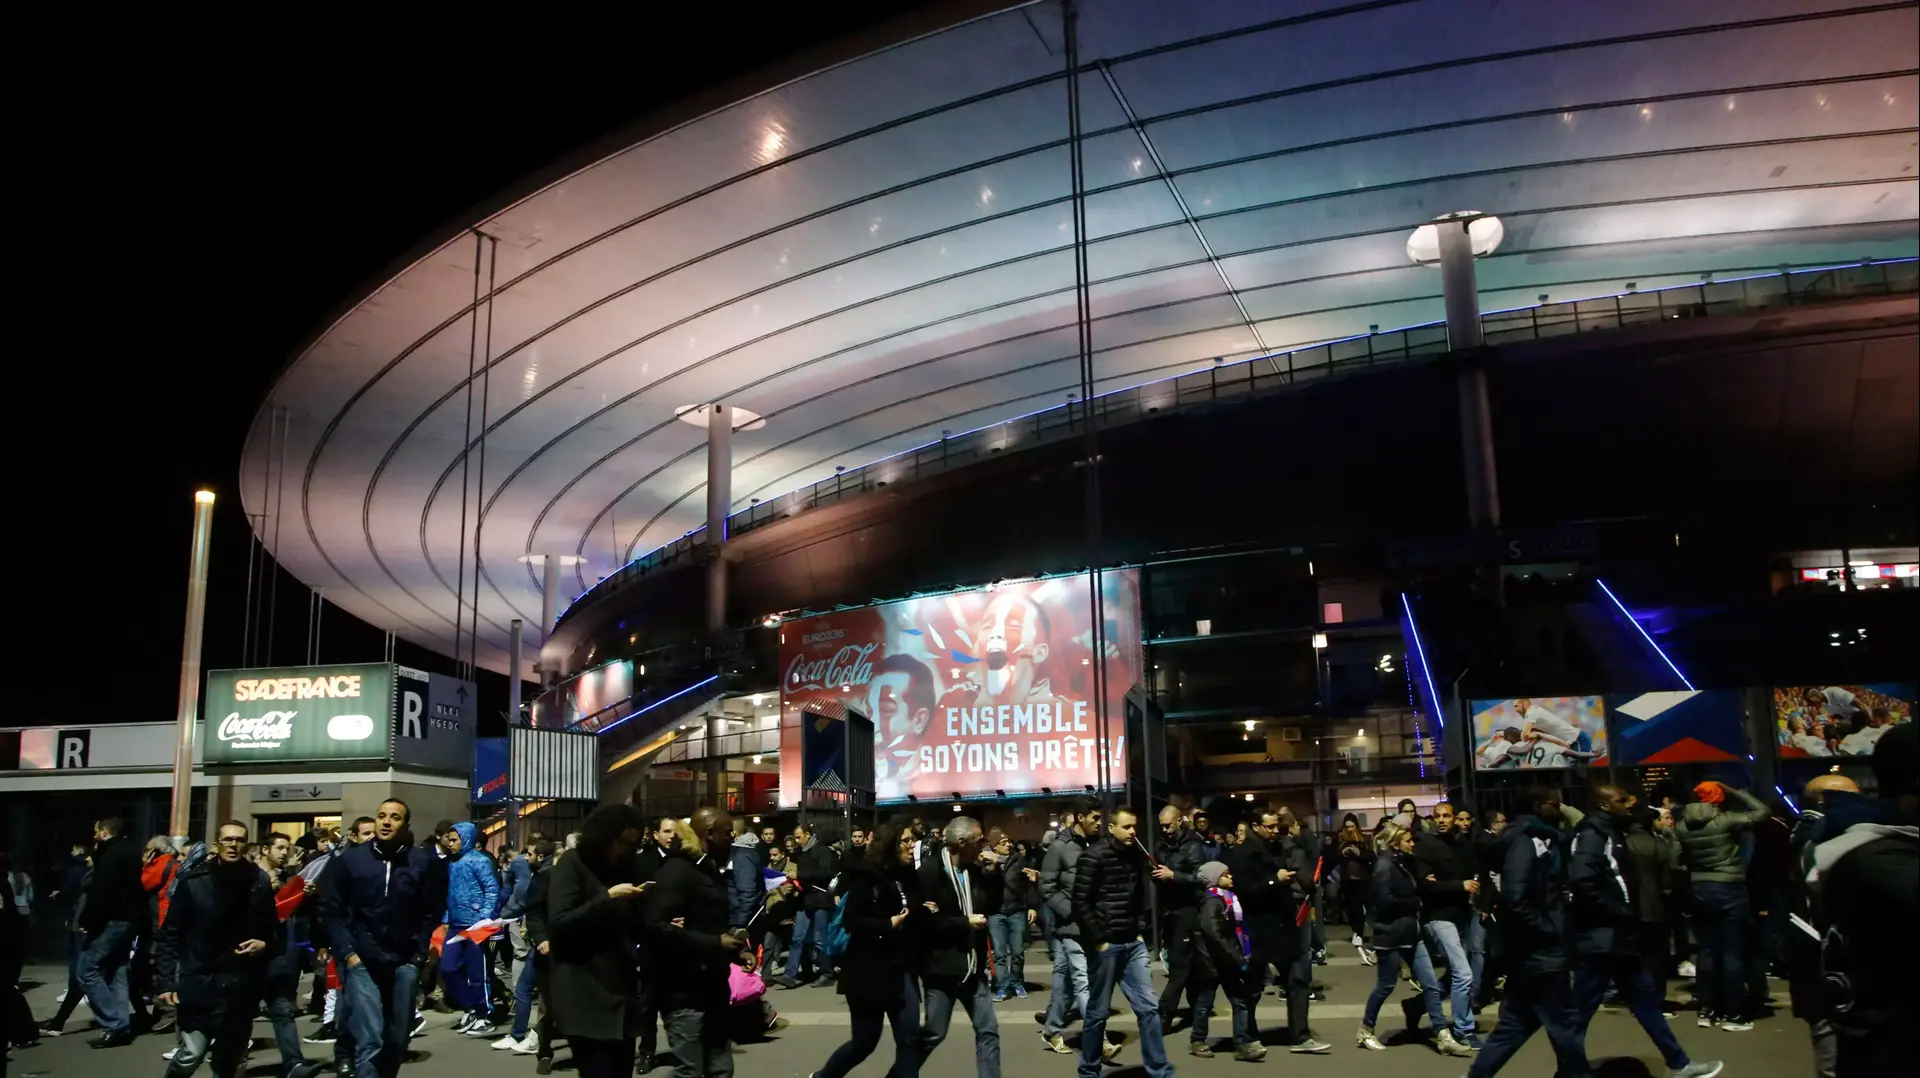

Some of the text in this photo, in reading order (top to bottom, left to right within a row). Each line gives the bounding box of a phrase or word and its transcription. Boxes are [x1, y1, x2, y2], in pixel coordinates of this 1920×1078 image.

[1508, 539, 1522, 559] S
[783, 642, 880, 694] Coca-Cola
[402, 690, 423, 740] R
[946, 701, 1088, 736] ENSEMBLE
[63, 737, 84, 768] R
[920, 741, 1019, 773] SOYONS
[1528, 746, 1545, 765] 19
